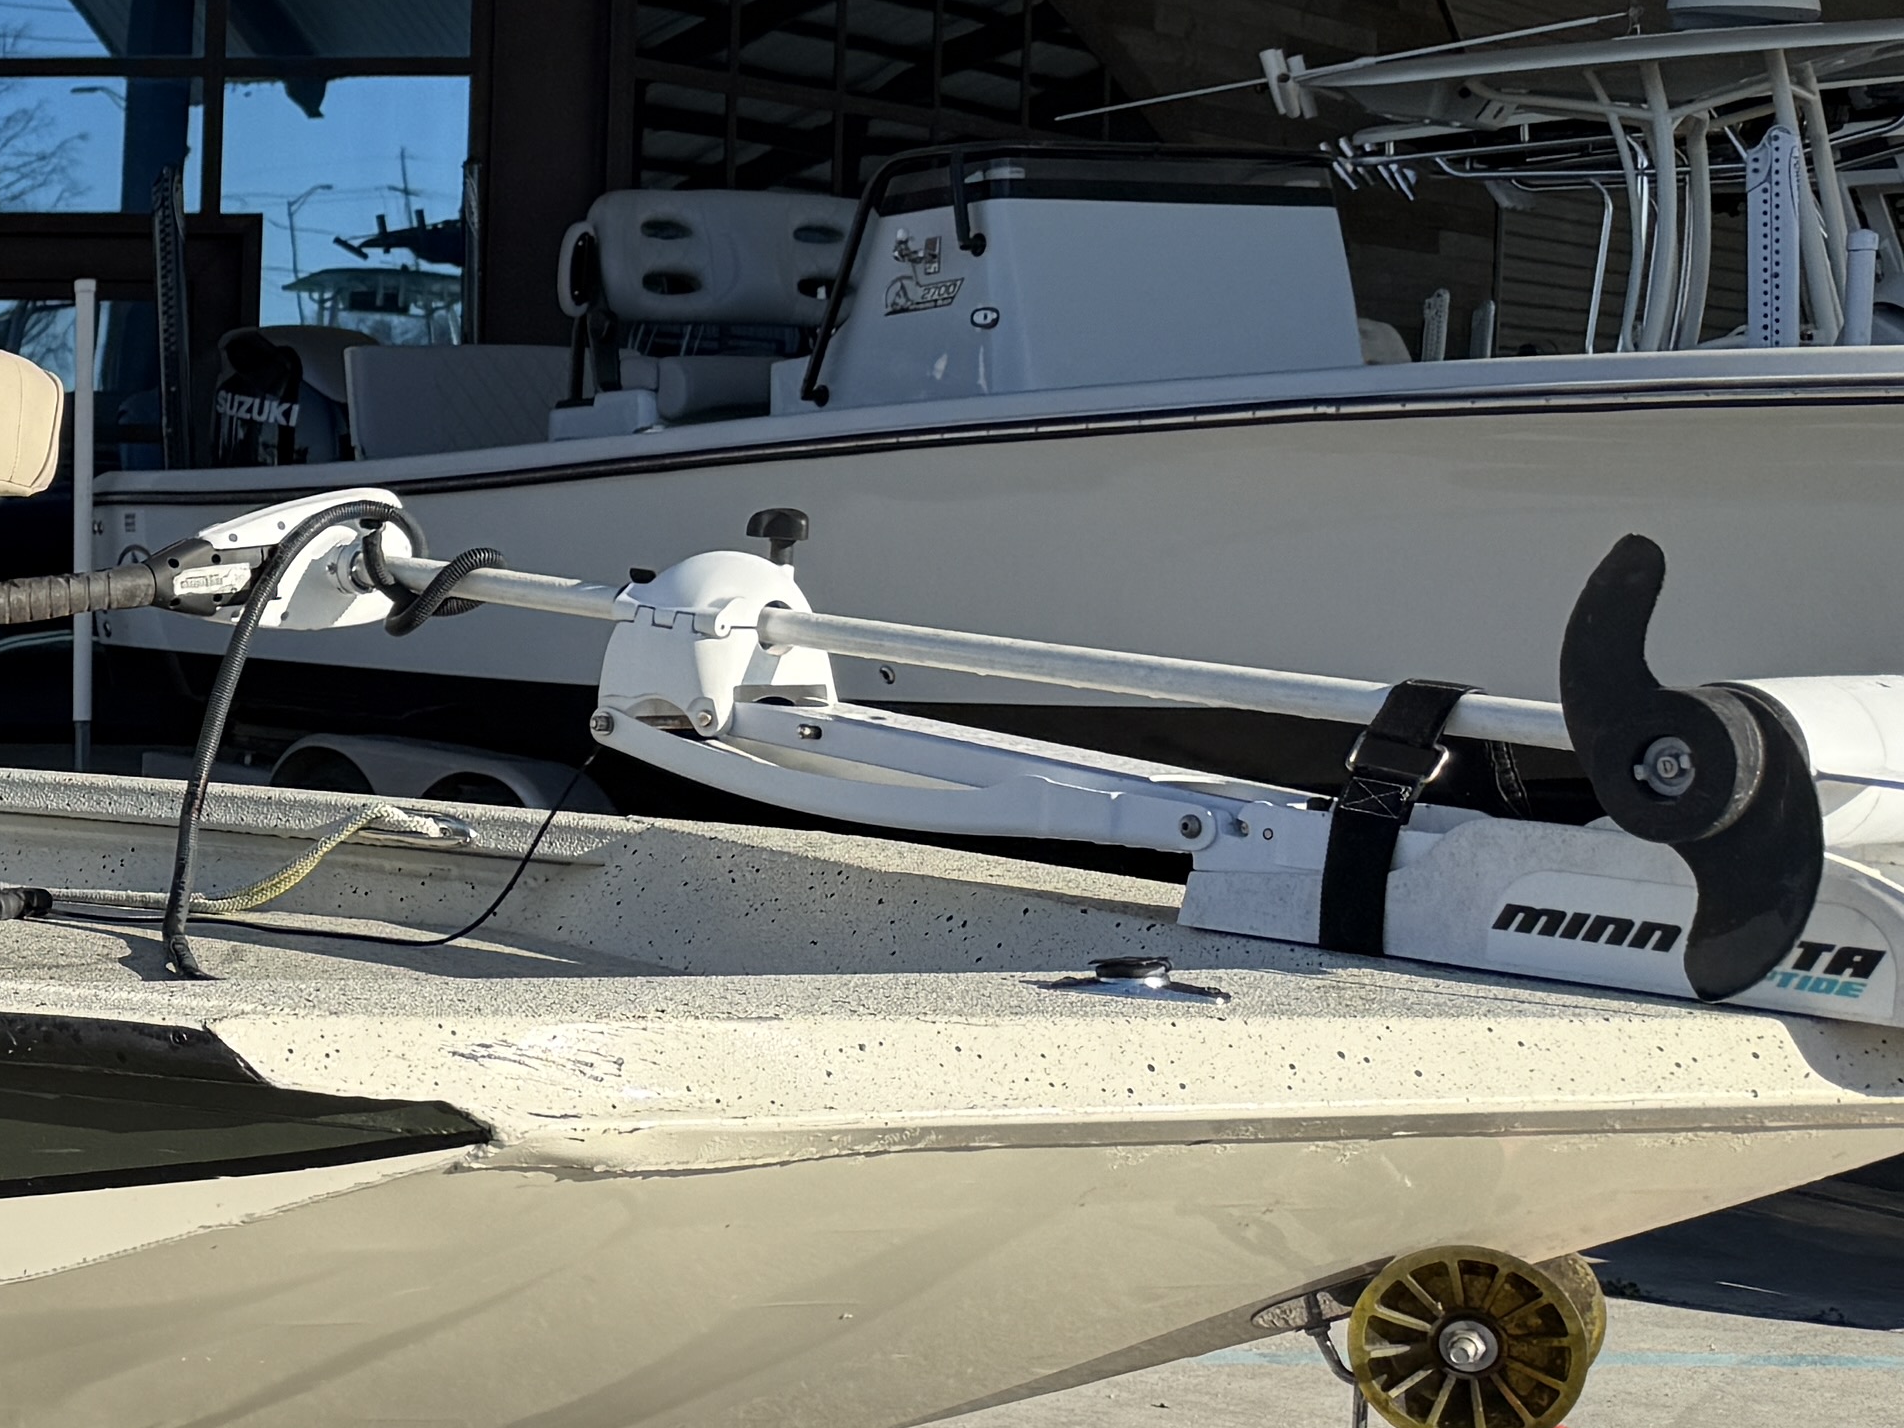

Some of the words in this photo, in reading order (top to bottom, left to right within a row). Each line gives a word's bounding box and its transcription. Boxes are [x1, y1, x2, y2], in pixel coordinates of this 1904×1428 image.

[215, 389, 300, 428] SUZUKI
[1791, 939, 1887, 979] TA
[1766, 969, 1869, 999] TIDE
